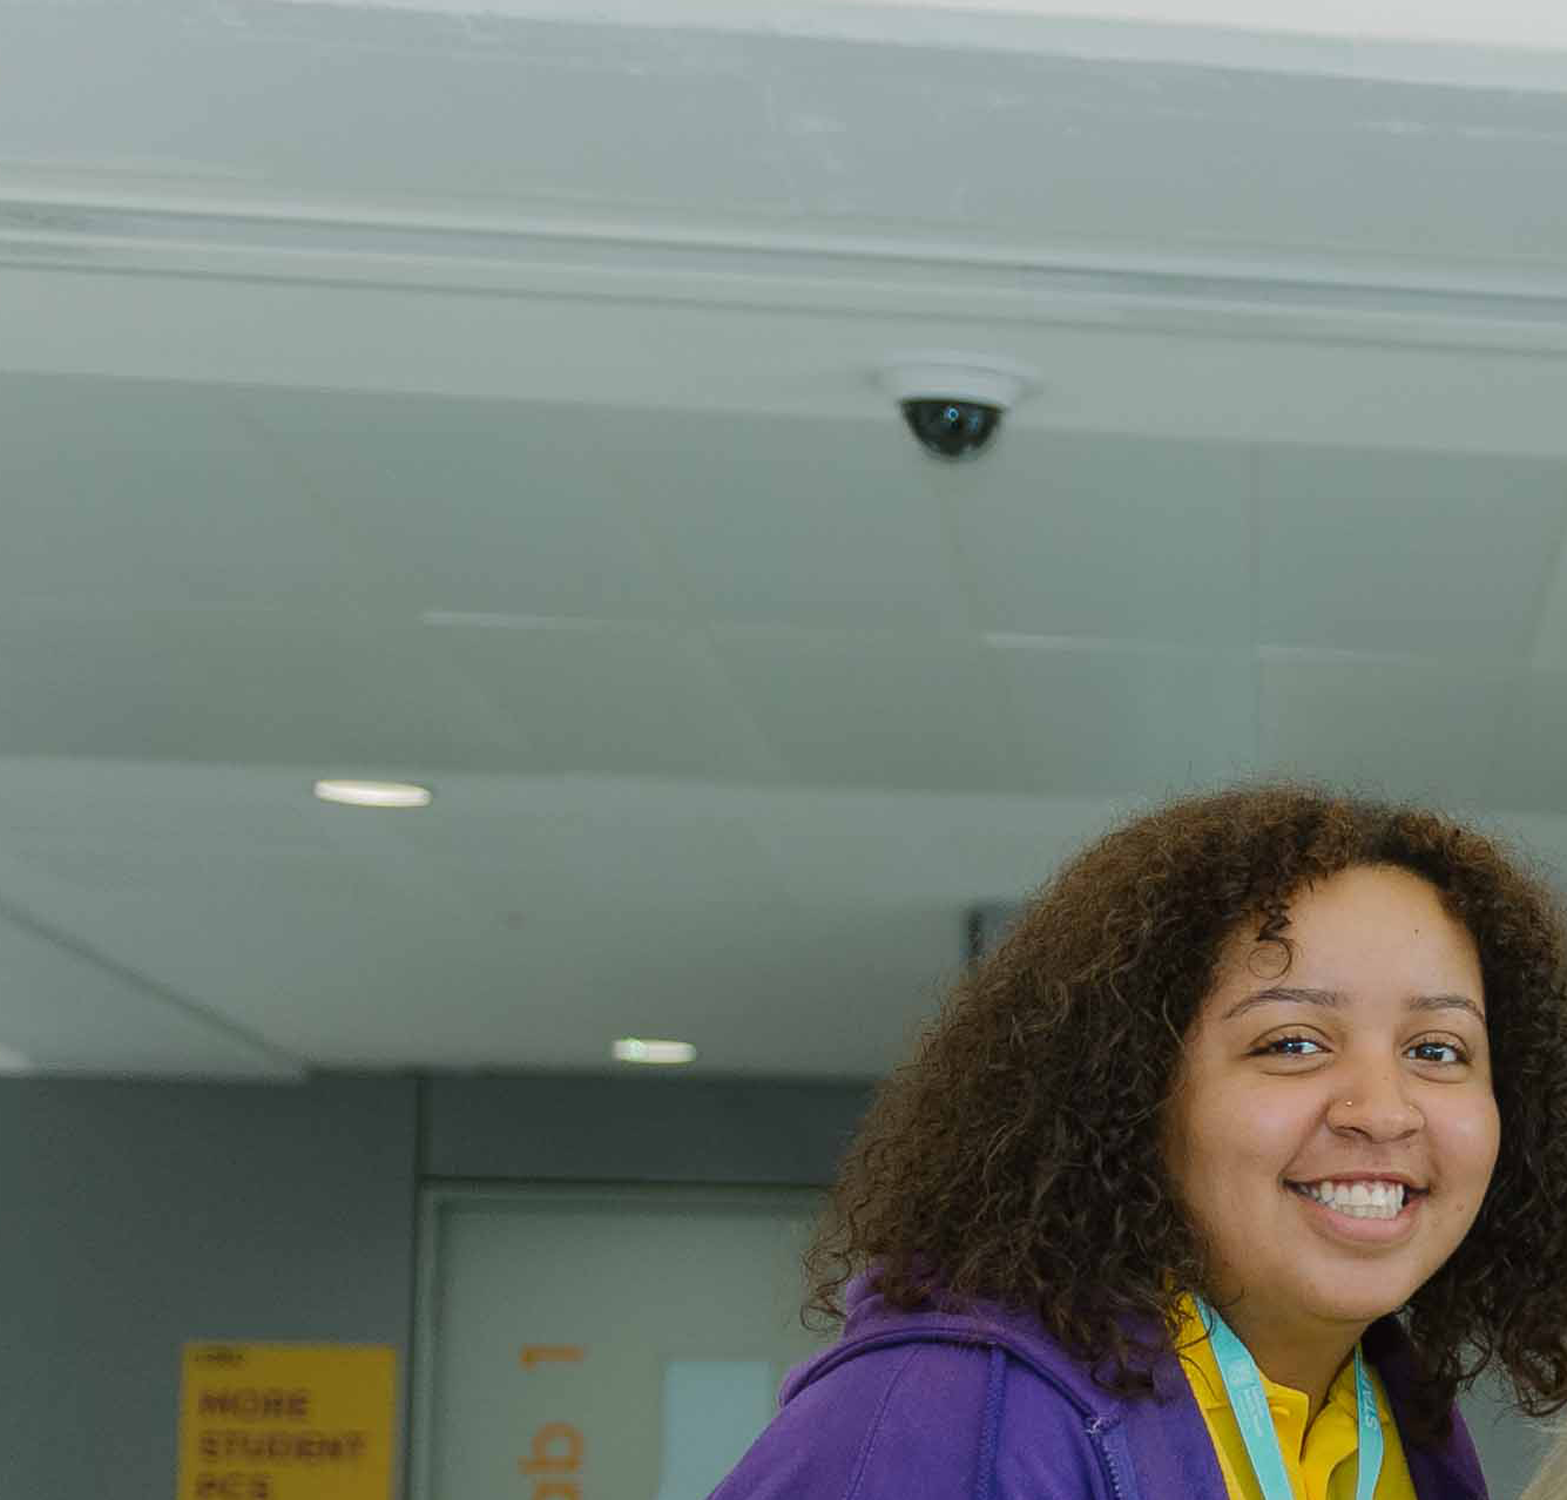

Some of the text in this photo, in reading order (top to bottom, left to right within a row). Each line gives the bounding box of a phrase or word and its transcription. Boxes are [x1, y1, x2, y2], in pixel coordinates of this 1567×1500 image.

[518, 1343, 584, 1370] 1
[199, 1388, 309, 1418] MORE
[199, 1431, 367, 1461] STUDENT
